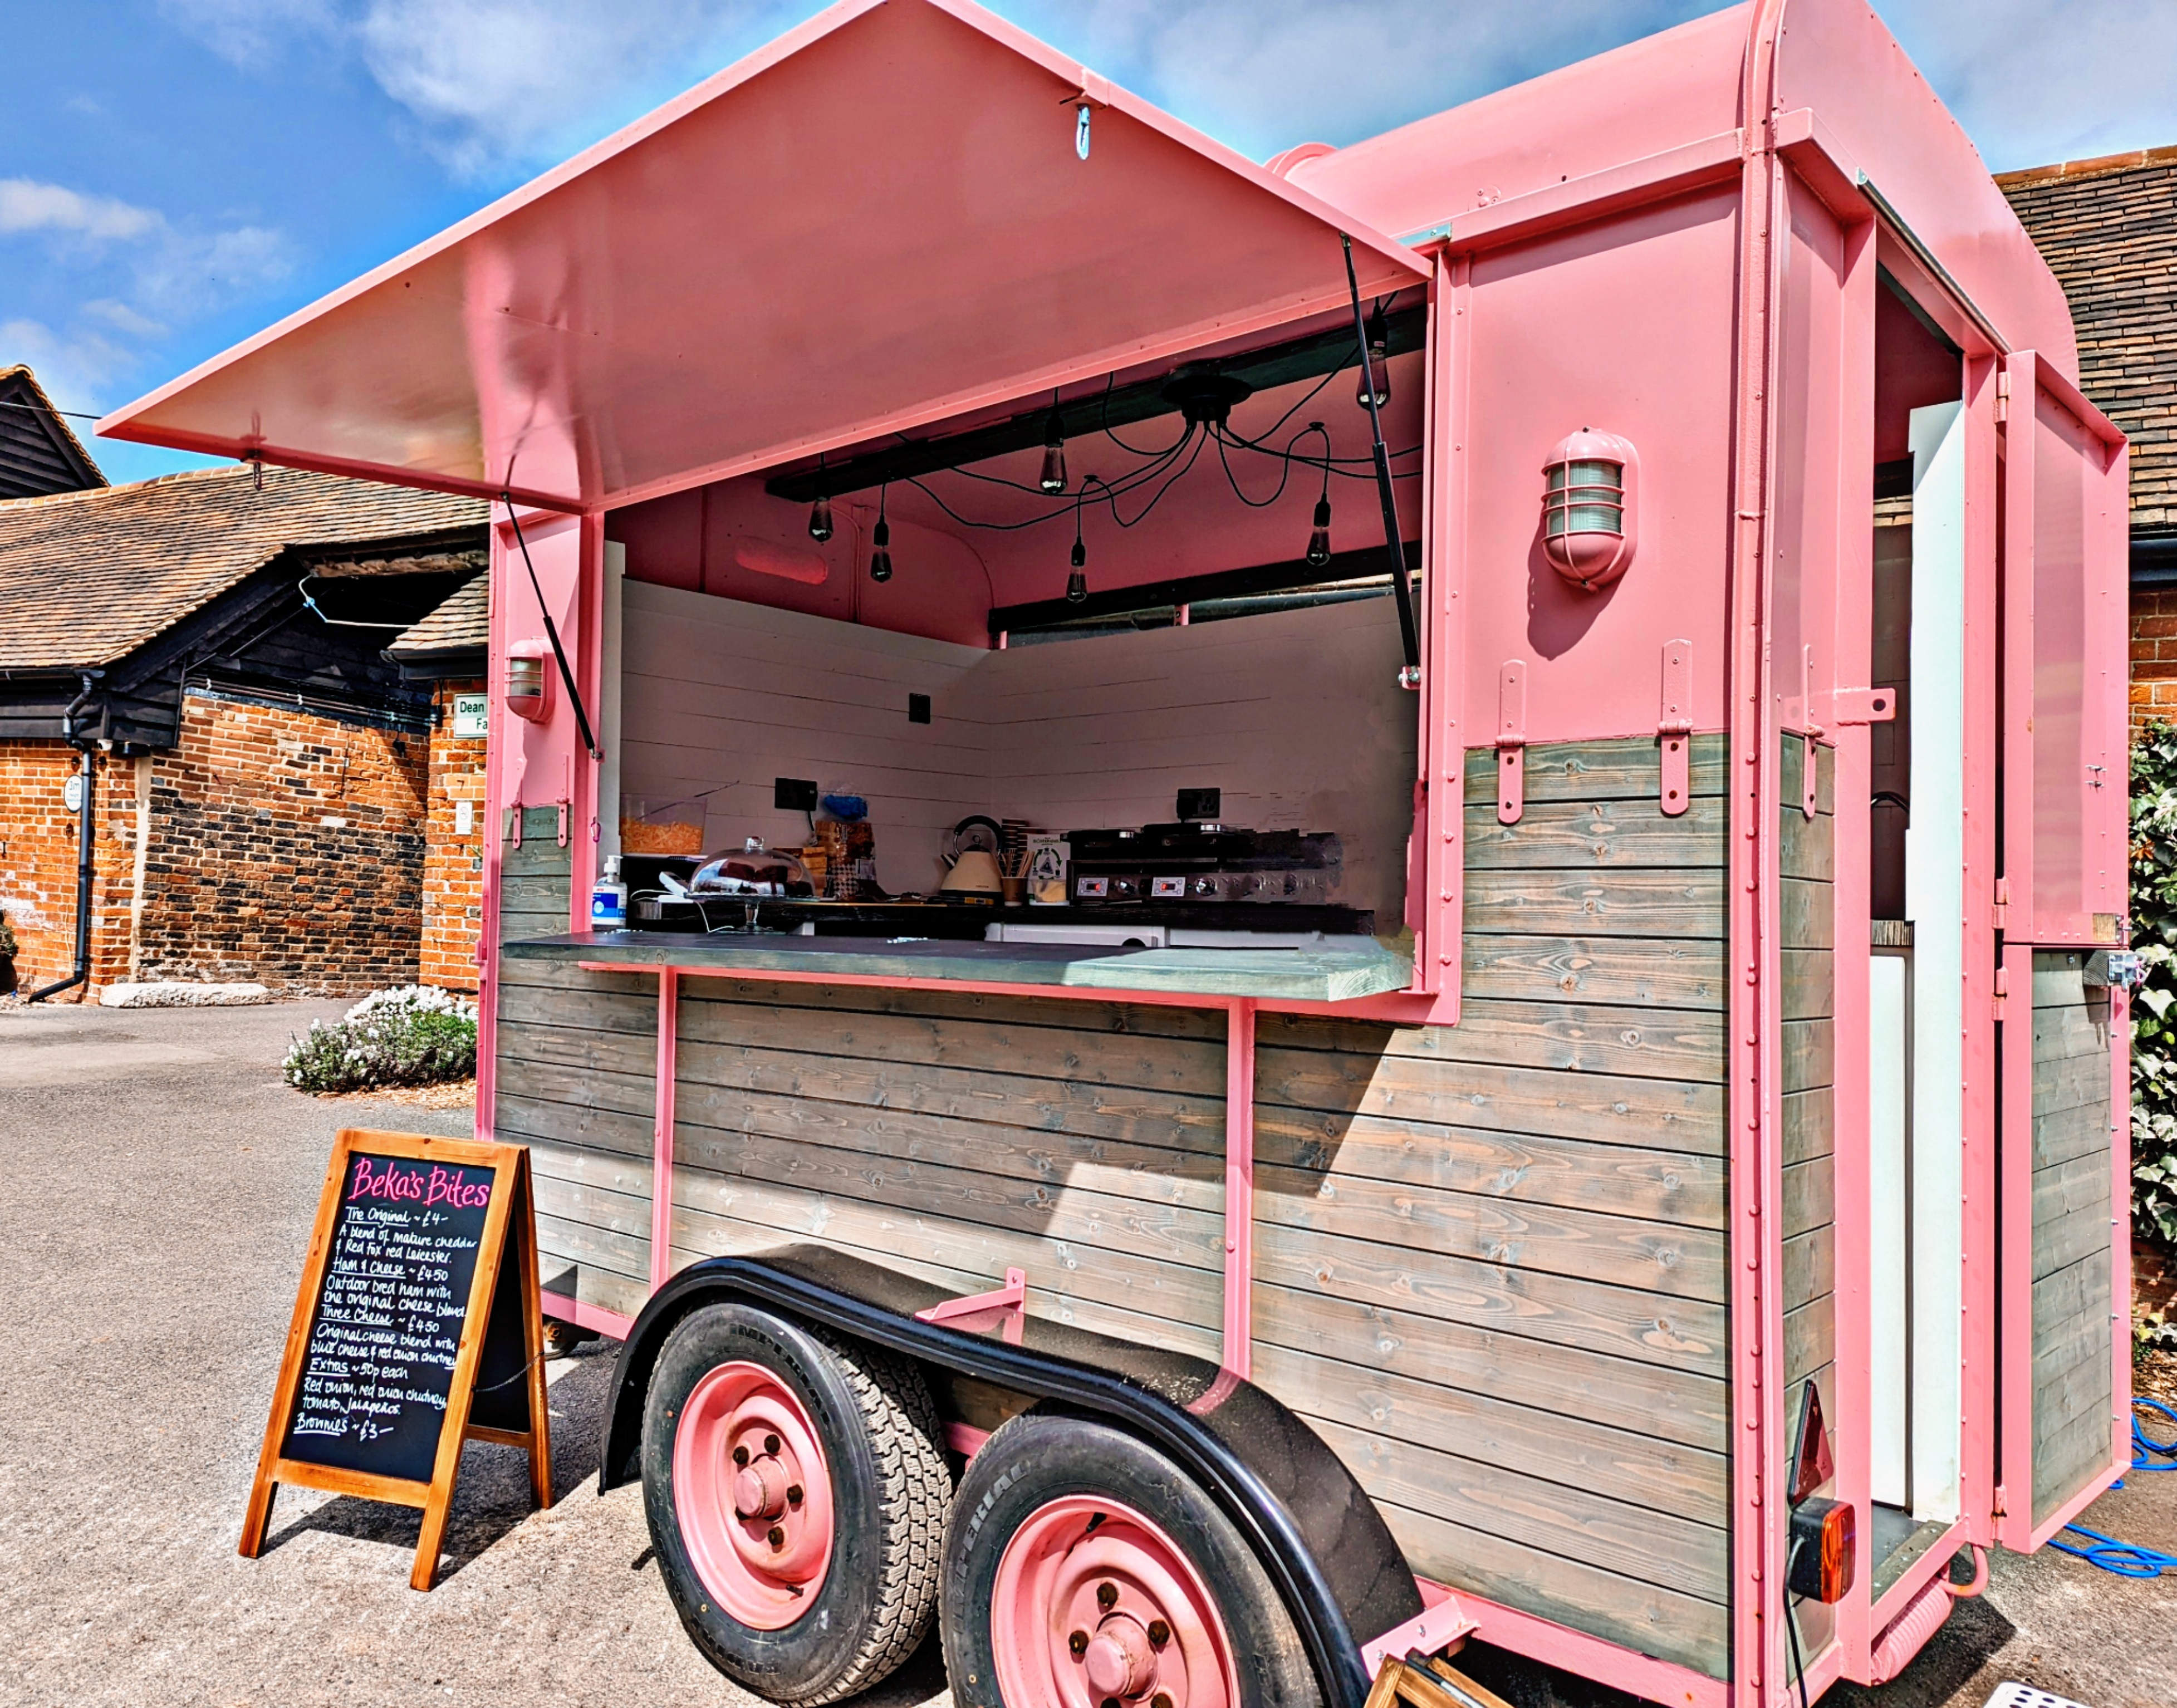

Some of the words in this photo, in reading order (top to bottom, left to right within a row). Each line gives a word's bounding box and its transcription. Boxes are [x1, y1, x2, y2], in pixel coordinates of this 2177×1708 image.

[460, 701, 484, 713] Dean
[347, 1158, 424, 1200] Beka's
[423, 1166, 489, 1208] Bites
[345, 1206, 364, 1221] The
[367, 1208, 411, 1228] Original
[339, 1224, 346, 1236] A
[350, 1225, 375, 1239] blend
[379, 1229, 390, 1246] of
[393, 1231, 432, 1246] mature
[435, 1236, 477, 1248] cheddar
[345, 1239, 364, 1254] Red
[366, 1242, 383, 1255] Fox
[386, 1247, 403, 1258] red
[333, 1256, 357, 1272] Ham
[370, 1260, 406, 1275] Cheese
[326, 1274, 370, 1292] Outdoor
[372, 1280, 395, 1295] bred
[398, 1283, 423, 1297] ham
[426, 1284, 452, 1299] with
[323, 1290, 343, 1304] the
[346, 1292, 395, 1312] original
[398, 1298, 435, 1313] cheese
[321, 1304, 351, 1319] Three
[354, 1308, 394, 1324] Cheese
[316, 1323, 360, 1347] Original
[362, 1331, 397, 1344] cheese
[400, 1334, 431, 1348] blend
[435, 1337, 455, 1352] with
[311, 1339, 335, 1354] blue
[337, 1343, 369, 1358] cheese
[377, 1347, 391, 1359] red
[393, 1348, 419, 1362] onion
[310, 1357, 348, 1373] Extras
[381, 1365, 408, 1379] each
[729, 1323, 831, 1431] IMPERIAL
[304, 1377, 323, 1392] Red
[325, 1378, 356, 1396] onion,
[359, 1384, 376, 1397] red
[378, 1383, 403, 1400] onion
[295, 1412, 347, 1432] Brownies
[952, 1462, 1027, 1635] IMPERIAL
